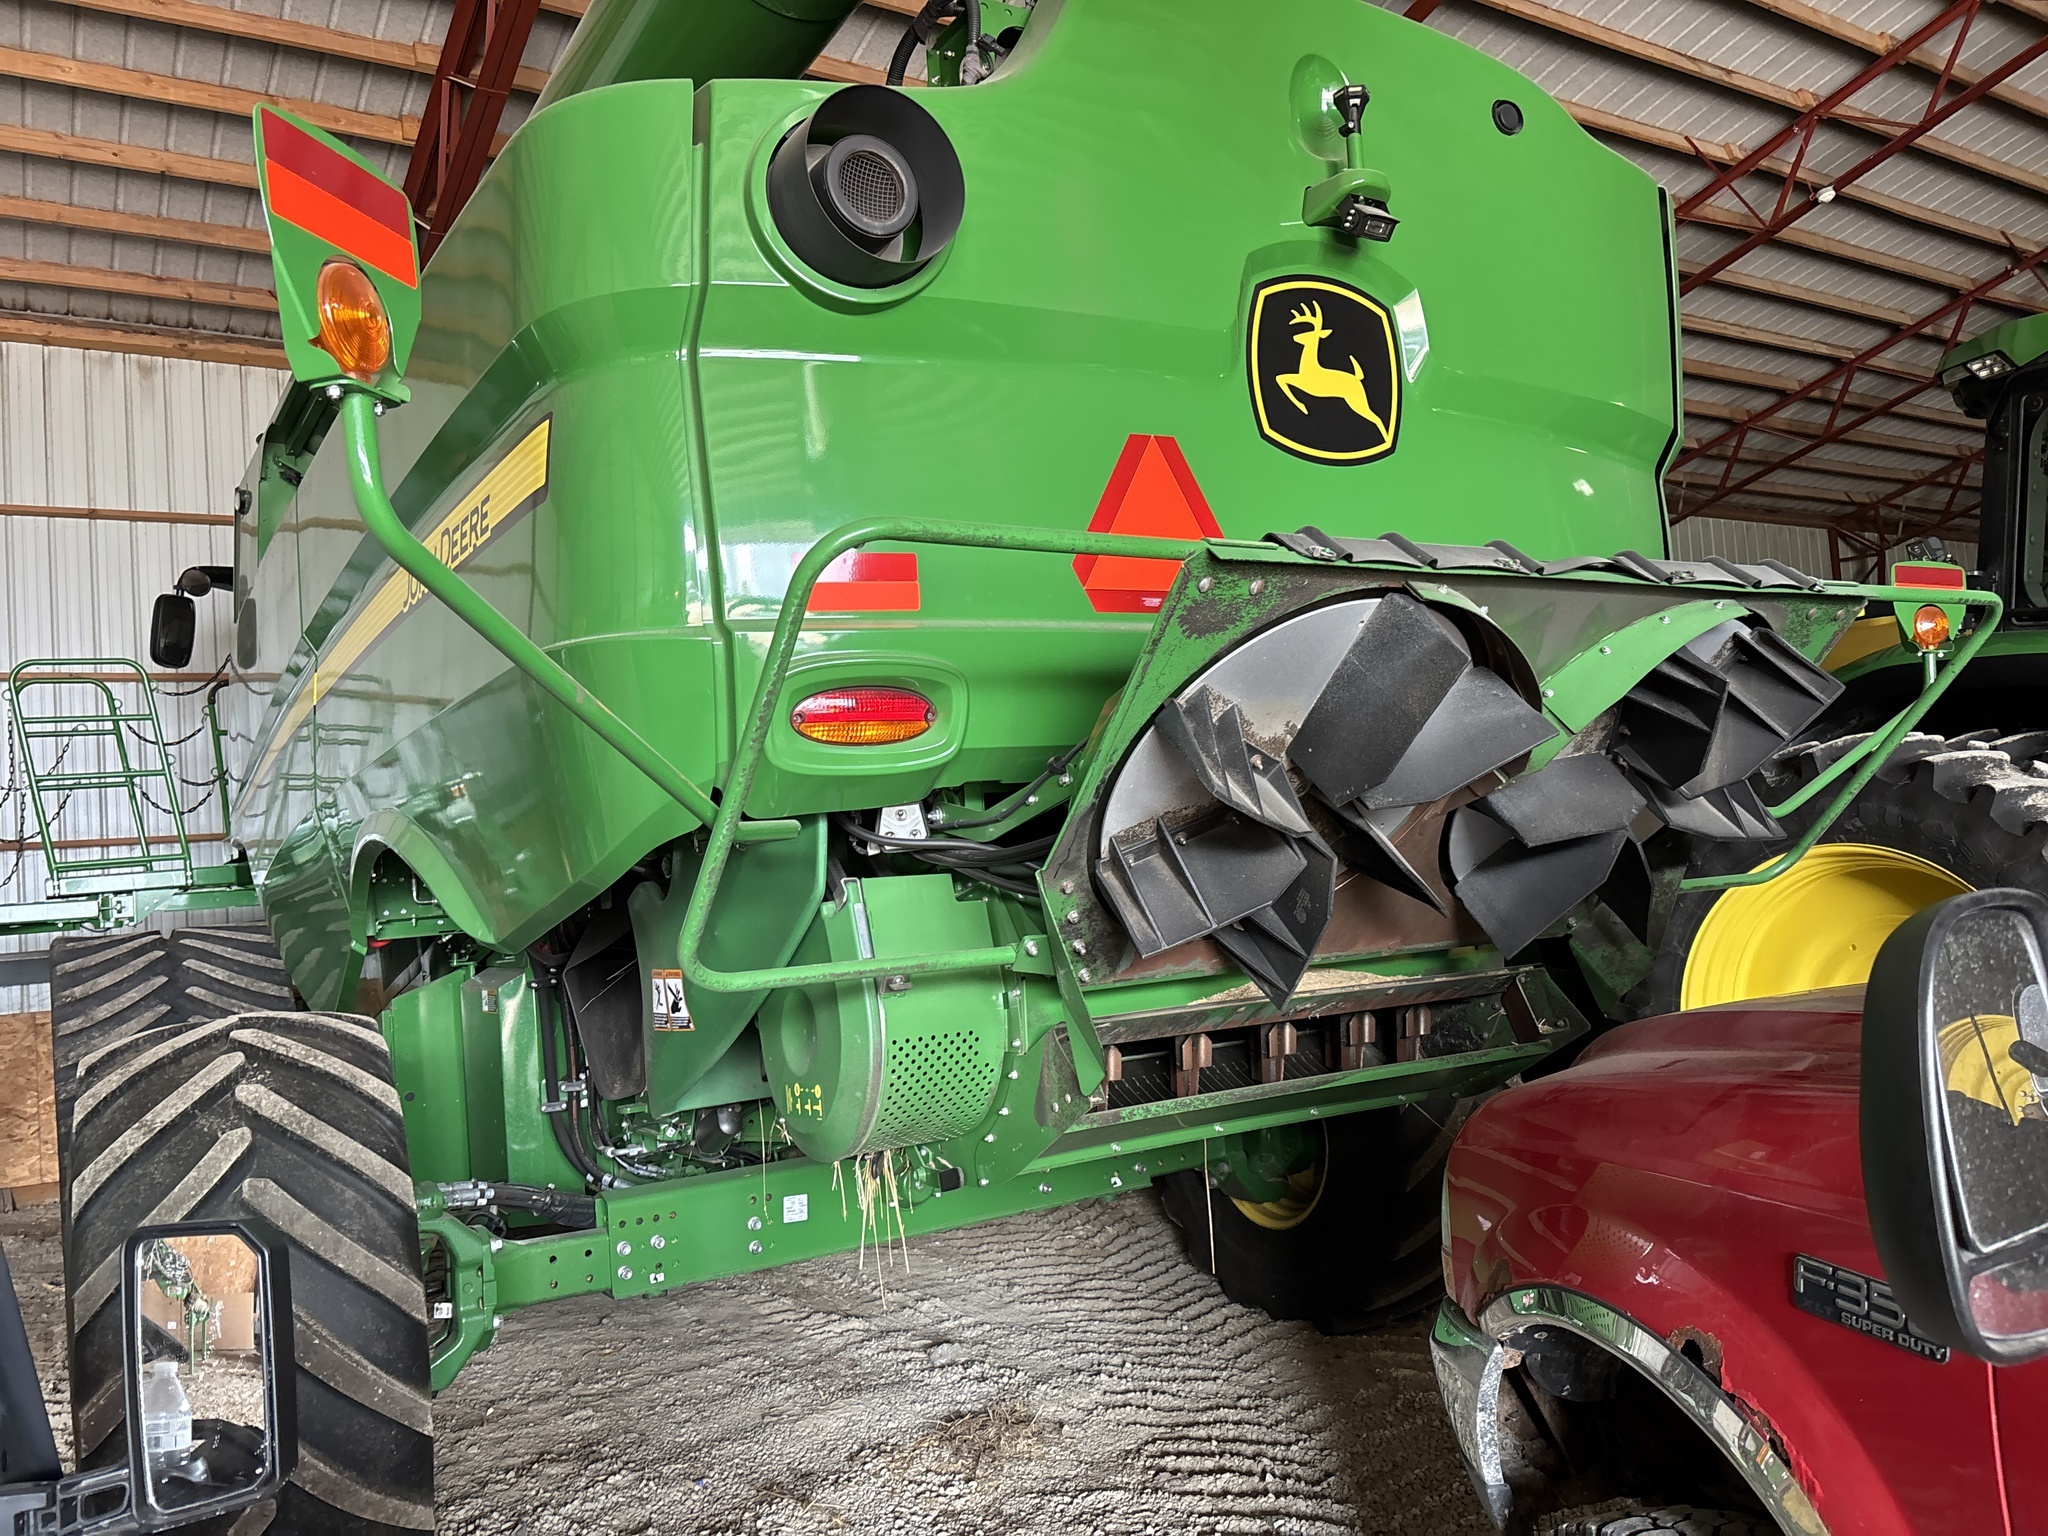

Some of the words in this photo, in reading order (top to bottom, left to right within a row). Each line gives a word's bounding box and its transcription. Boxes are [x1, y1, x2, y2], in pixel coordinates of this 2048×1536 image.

[440, 493, 491, 567] DEERE
[1794, 1255, 1928, 1334] F-35
[1801, 1297, 1835, 1317] XLT
[1840, 1311, 1895, 1341] SUPER
[1897, 1333, 1946, 1360] DUTY
